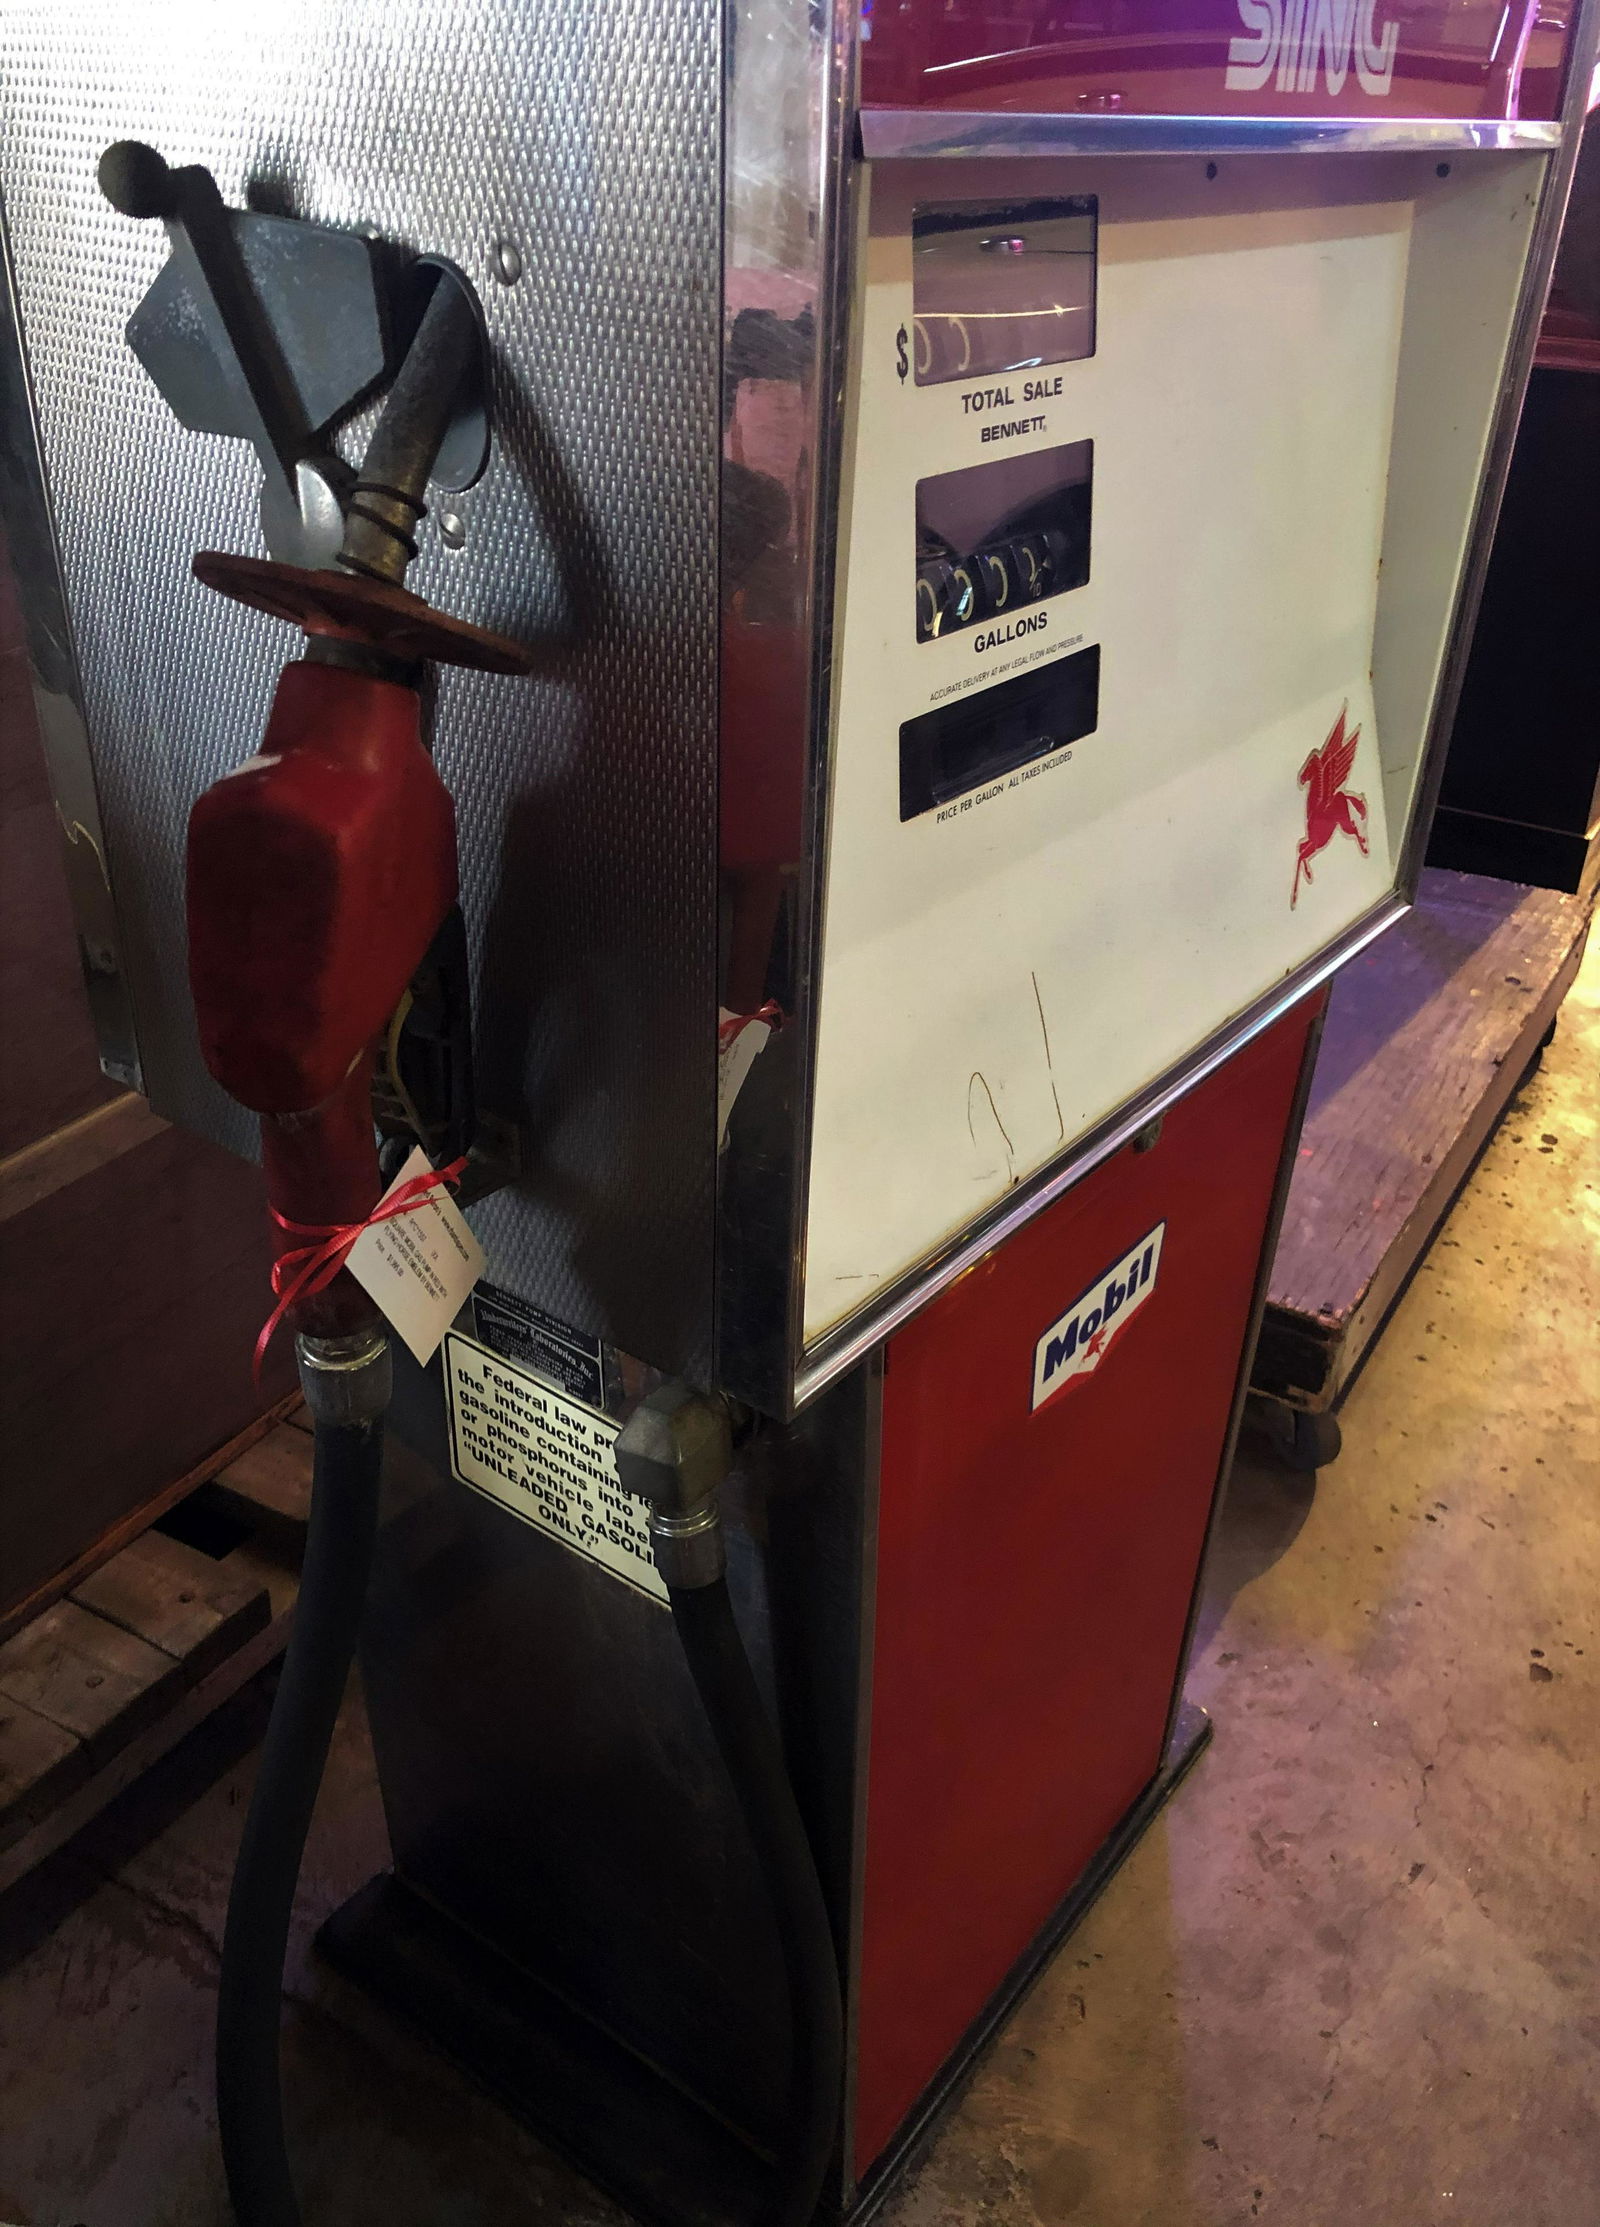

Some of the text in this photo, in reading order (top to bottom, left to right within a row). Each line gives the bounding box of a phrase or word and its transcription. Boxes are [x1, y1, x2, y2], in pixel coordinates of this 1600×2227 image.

[961, 377, 1063, 414] TOTAL SALE
[930, 633, 1084, 702] ACCURATE DELIVERY AT ANY LEGAL FLOW AND PRESSURE
[974, 611, 1048, 653] GALLONS
[936, 750, 1073, 824] PRICE PER GALLON ALL TAXES INCLUDED
[1042, 1242, 1154, 1385] Mobil
[458, 1368, 602, 1463] the introduction
[483, 1364, 587, 1435] Federal law
[459, 1390, 530, 1439] gasoline
[536, 1436, 632, 1500] containing
[461, 1408, 478, 1425] or
[487, 1423, 588, 1491] phosphorus
[598, 1486, 633, 1517] into
[462, 1426, 651, 1546] motor vehicle labe
[582, 1513, 653, 1565] GASOLI
